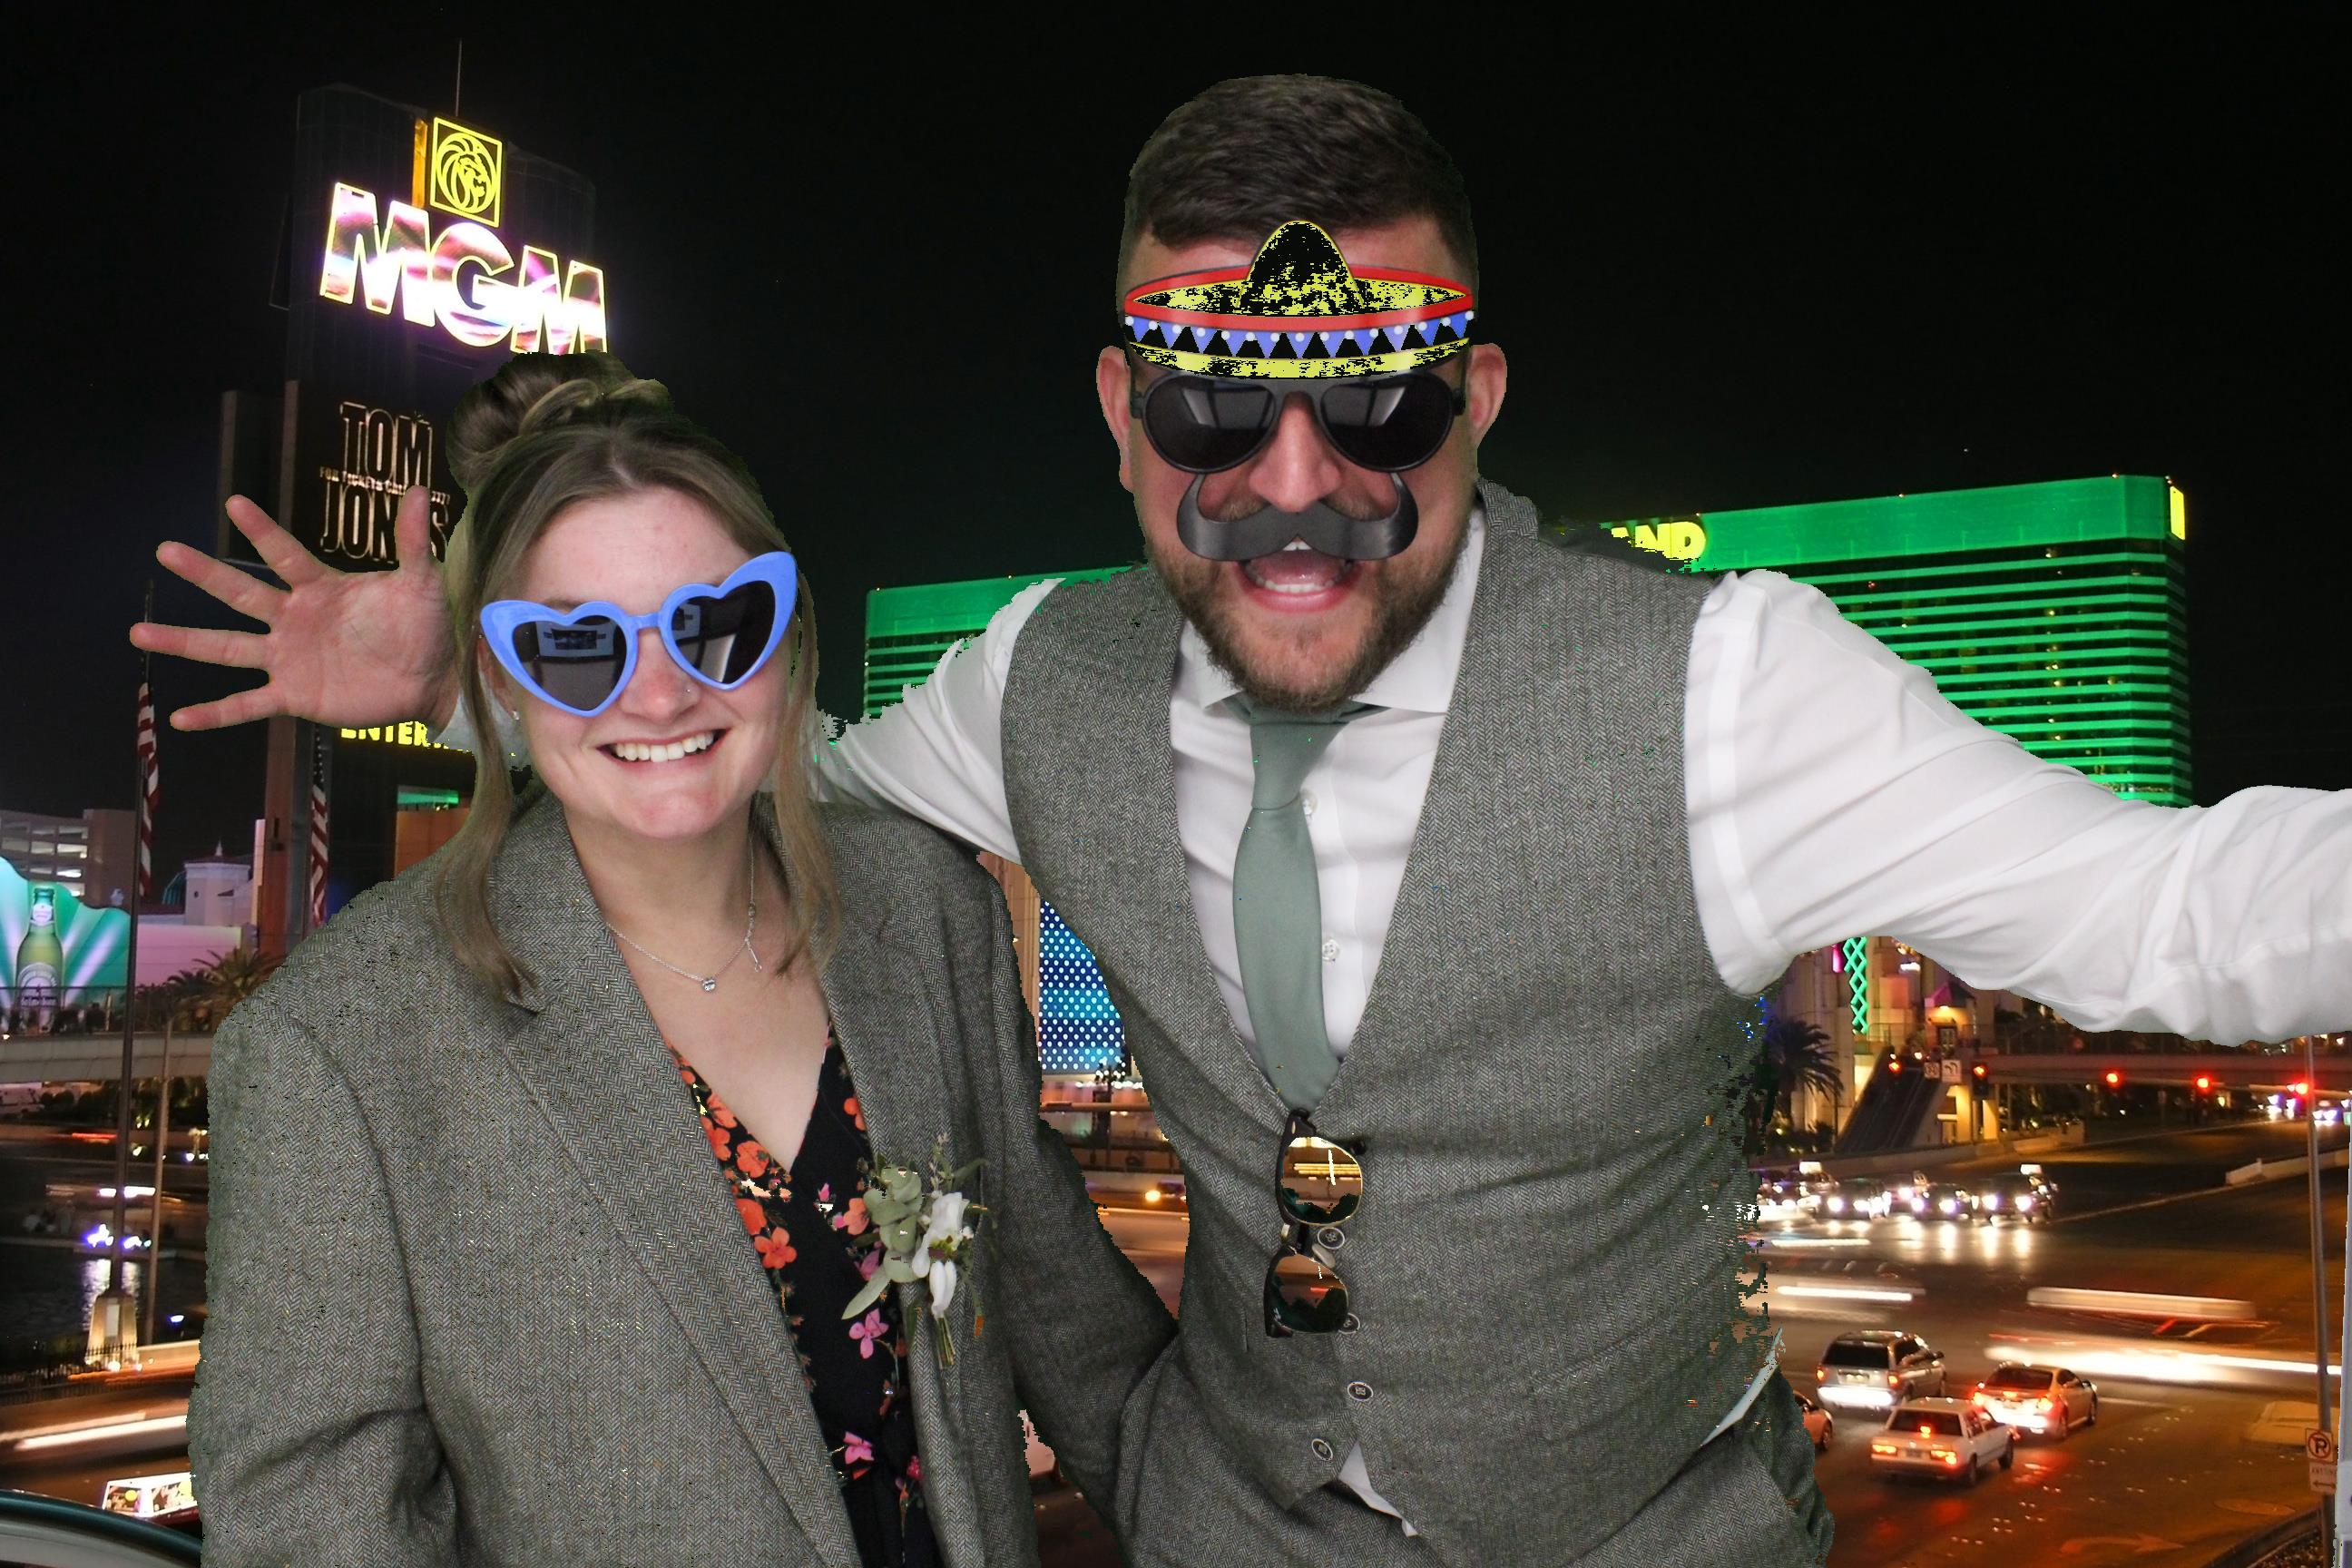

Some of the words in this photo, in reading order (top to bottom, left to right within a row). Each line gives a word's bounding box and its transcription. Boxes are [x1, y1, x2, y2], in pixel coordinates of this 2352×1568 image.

[320, 182, 607, 355] MGM
[338, 400, 433, 488] TOM
[320, 479, 450, 564] JONS
